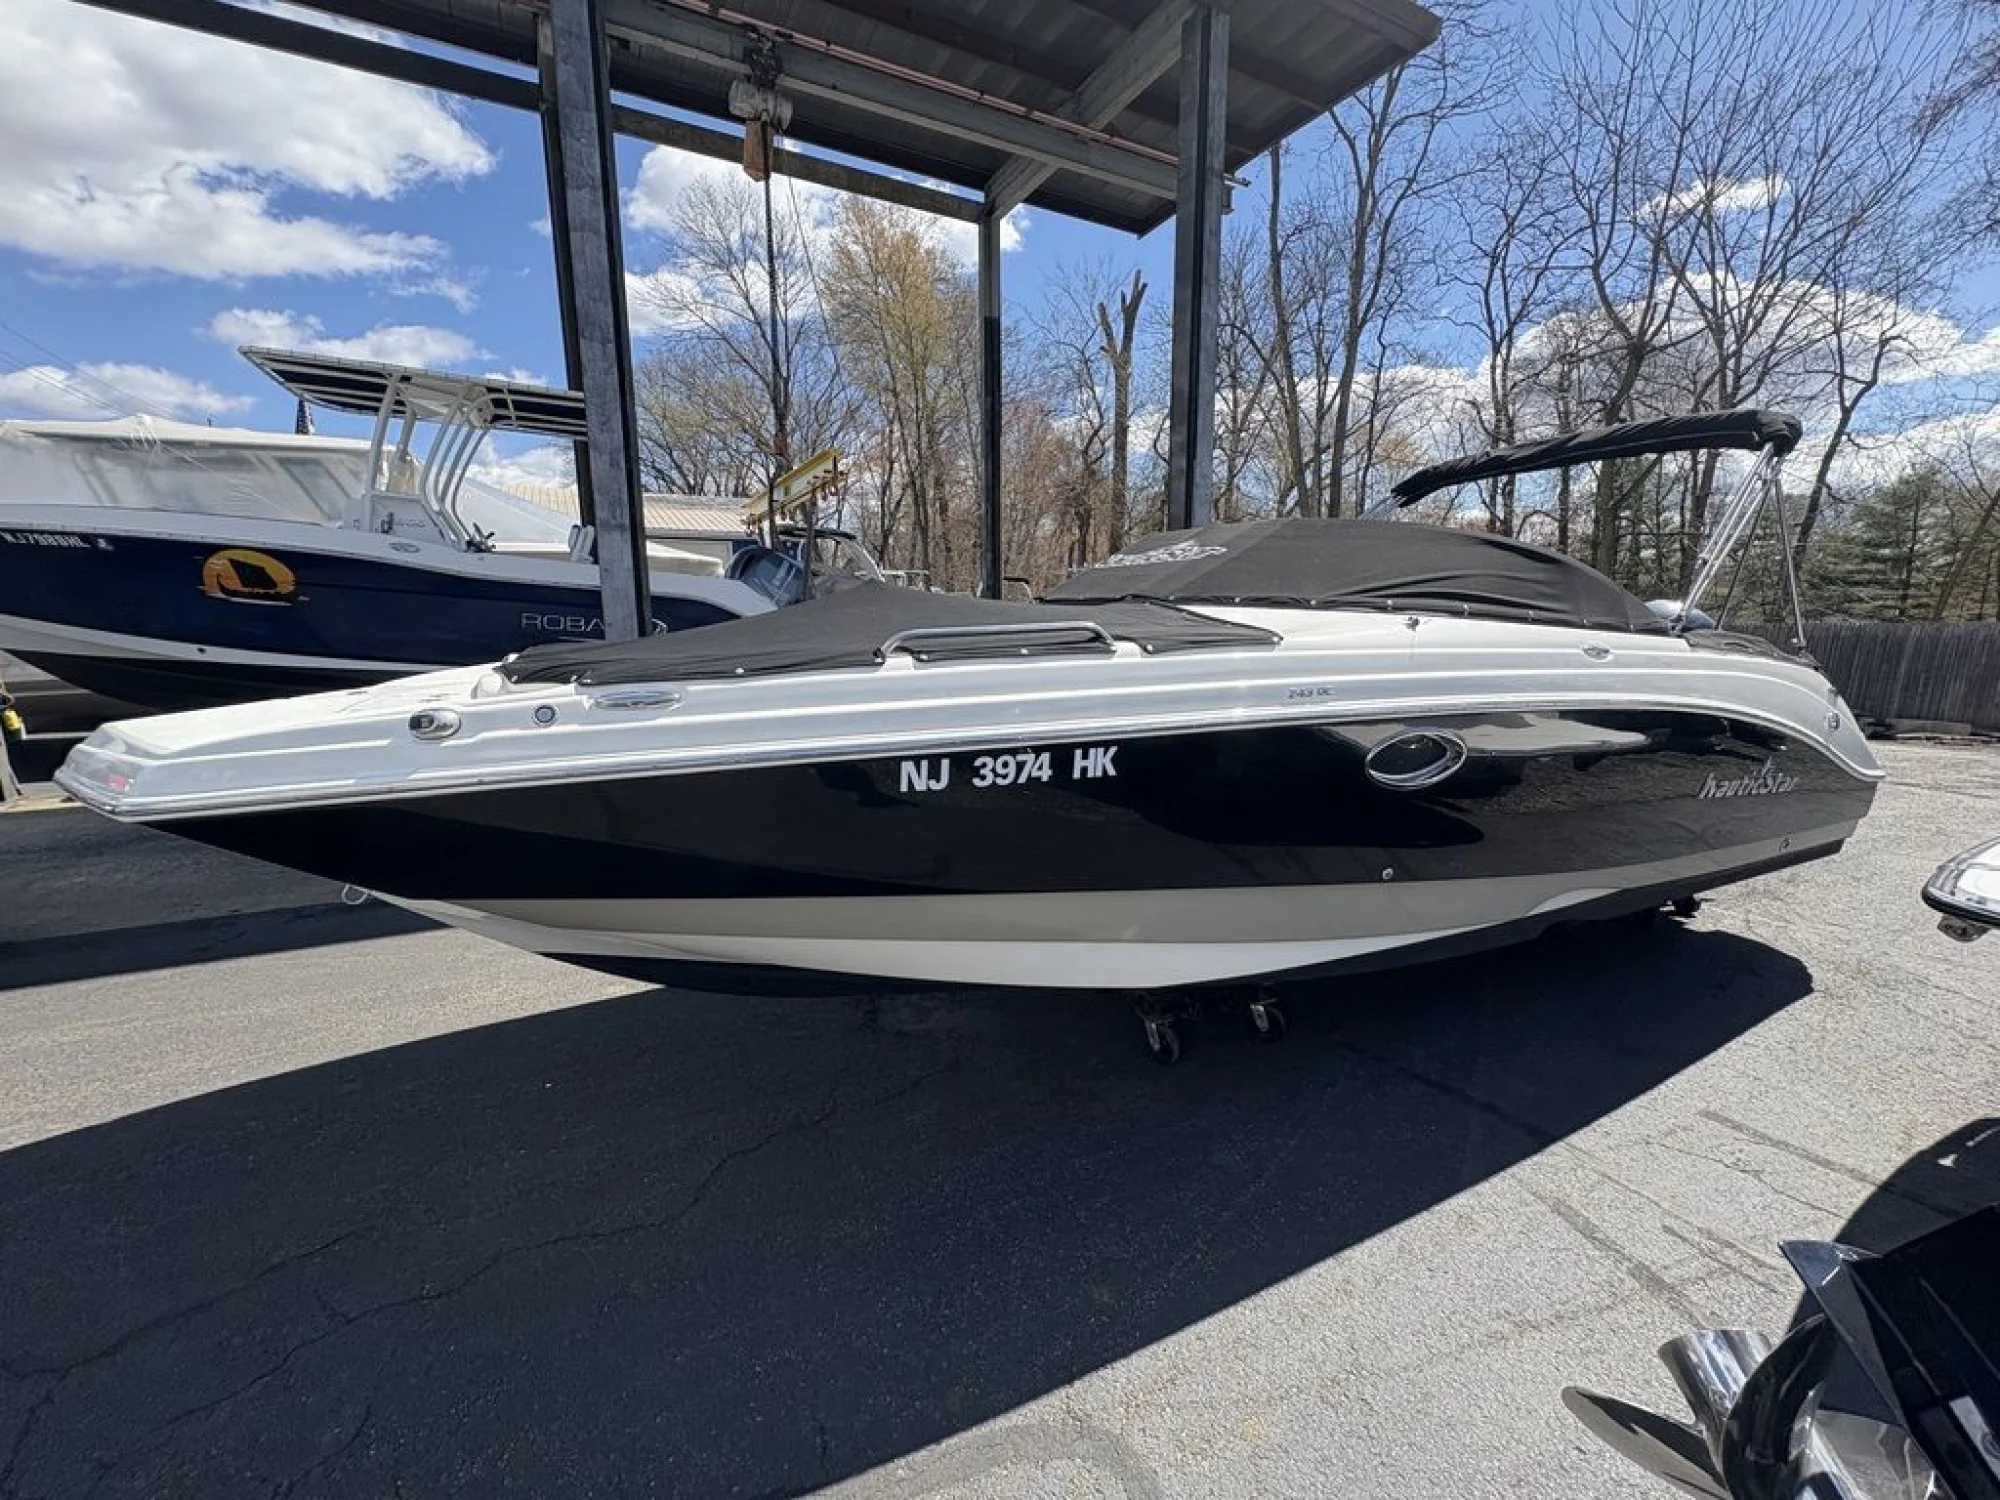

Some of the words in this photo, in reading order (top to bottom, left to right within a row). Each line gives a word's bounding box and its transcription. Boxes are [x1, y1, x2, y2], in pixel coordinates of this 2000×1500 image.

[520, 612, 605, 632] ROBA
[899, 758, 950, 792] NJ
[972, 752, 1053, 788] 3974
[1072, 746, 1118, 779] HK
